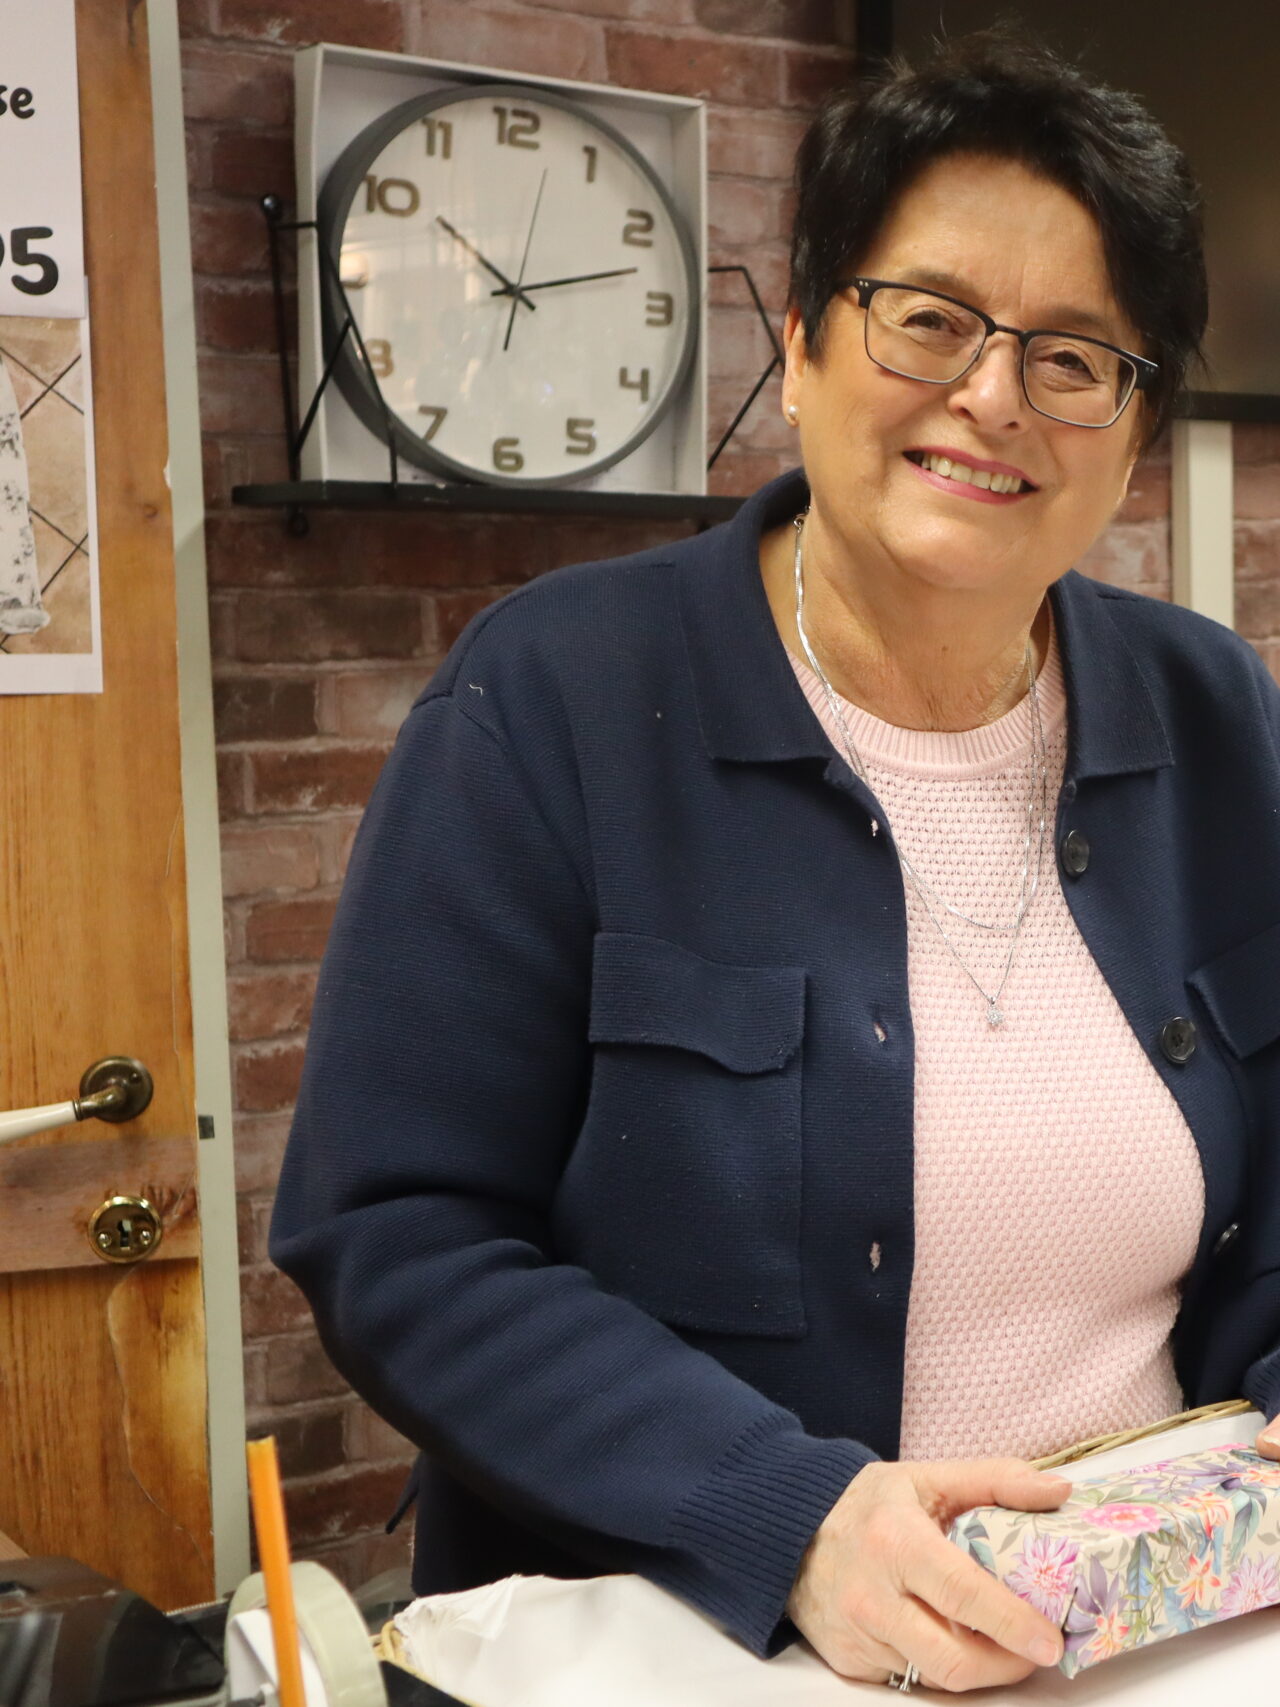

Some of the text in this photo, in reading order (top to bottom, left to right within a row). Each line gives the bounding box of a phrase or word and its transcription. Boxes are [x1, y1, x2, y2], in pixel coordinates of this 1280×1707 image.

[420, 117, 453, 160] 11
[493, 106, 541, 150] 12
[582, 145, 598, 183] 1
[363, 174, 421, 218] 10
[621, 208, 654, 248] 2
[645, 291, 673, 327] 3
[618, 366, 650, 403] 4
[418, 405, 448, 442] 7
[565, 417, 597, 456] 5
[492, 437, 524, 472] 6
